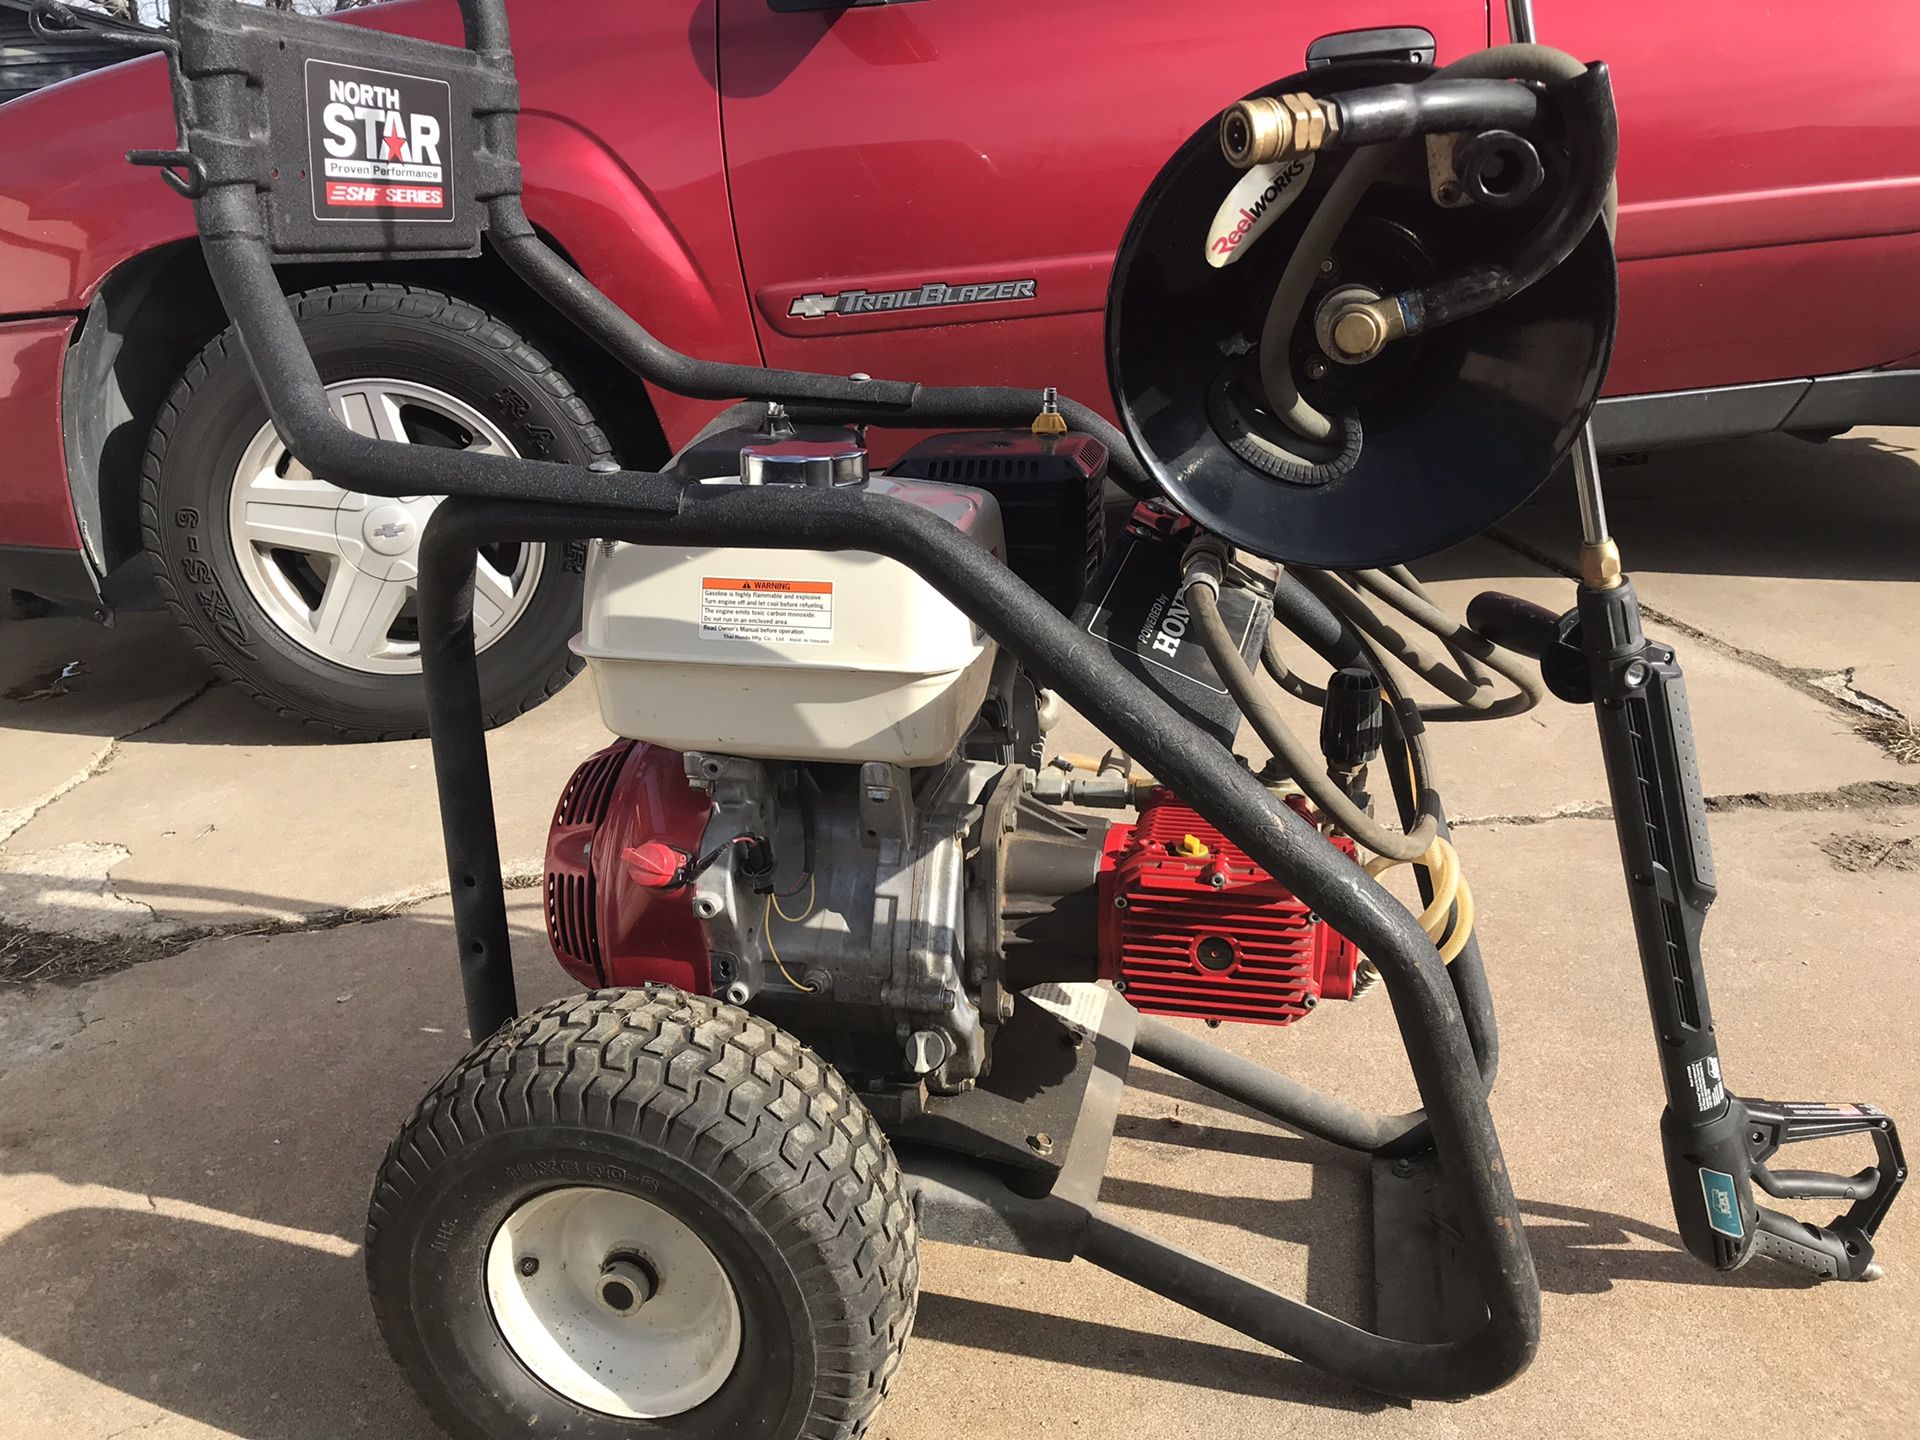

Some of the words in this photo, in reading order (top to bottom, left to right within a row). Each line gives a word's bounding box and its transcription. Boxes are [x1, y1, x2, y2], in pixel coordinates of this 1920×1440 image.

[329, 79, 399, 110] NORTH
[323, 102, 442, 166] STAR
[330, 162, 370, 175] Proven
[373, 165, 438, 179] Performance
[385, 188, 441, 204] SERIES
[754, 581, 791, 590] WARNING
[735, 591, 751, 599] highly
[1137, 602, 1164, 645] POWERED
